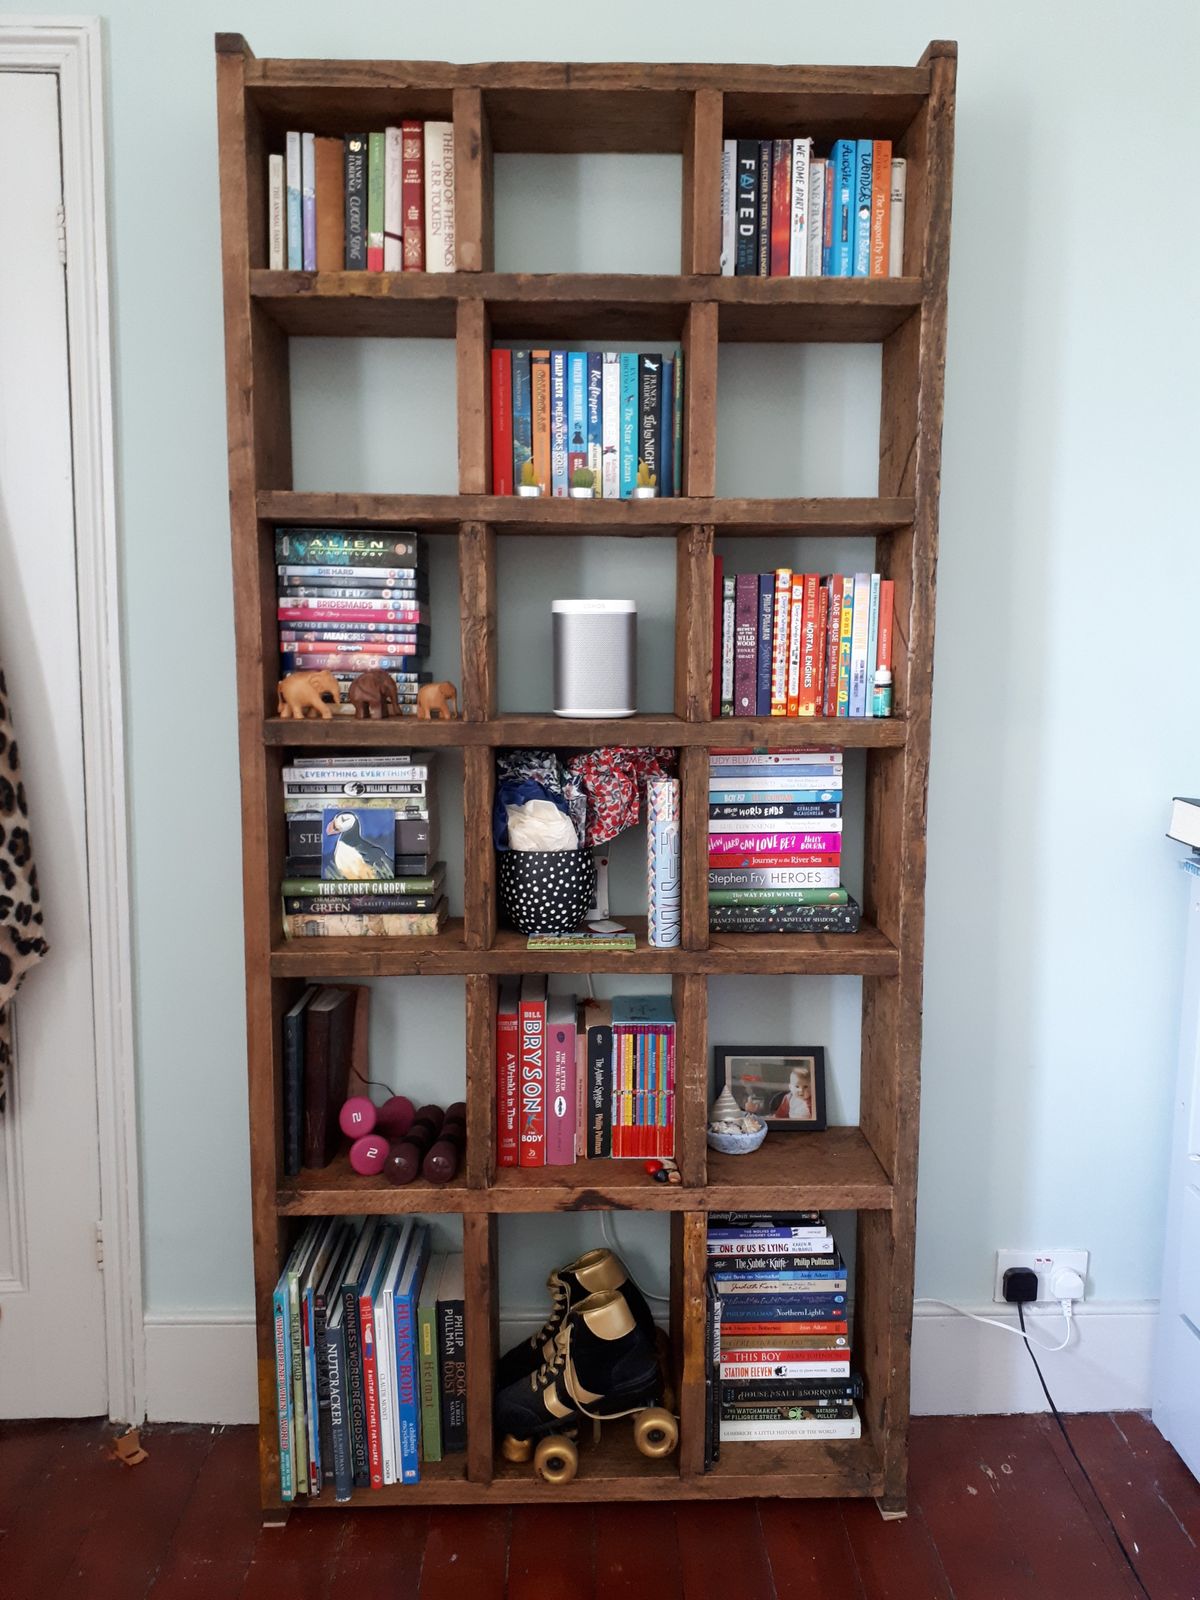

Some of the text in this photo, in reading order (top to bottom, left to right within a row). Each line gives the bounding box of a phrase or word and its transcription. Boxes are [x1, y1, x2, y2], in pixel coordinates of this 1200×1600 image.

[795, 145, 805, 212] WE COME APART
[442, 132, 454, 267] THE LORD OF THE RINGS
[739, 159, 756, 237] FATED
[810, 168, 822, 242] ANNE FRANK
[349, 196, 361, 260] CUCKOO SONG
[874, 194, 885, 274] The Dragonfly Pool
[554, 354, 563, 398] PHILIP REEVE
[643, 374, 651, 412] HARDINGE
[649, 374, 657, 407] FRANCES
[624, 407, 633, 422] The
[624, 424, 633, 444] Star
[554, 453, 564, 476] GOLD
[624, 454, 634, 483] Kazan
[311, 539, 384, 548] ALIEN
[808, 577, 816, 598] PHILIP
[317, 600, 373, 609] BRIDESMAIDS
[762, 594, 772, 613] PHILIP
[762, 613, 771, 641] PULLMAN
[829, 593, 841, 688] SLADE HOUSE David Mitchell
[804, 621, 814, 688] MORTAL ENGINES
[739, 806, 784, 816] WORLD ENDS
[723, 834, 796, 852] HARD CAN LOVE BE?
[318, 882, 406, 895] THE SECRET GARDEN
[709, 872, 822, 885] Stephen Fry HEROES
[310, 902, 351, 912] GREEN
[522, 1020, 543, 1113] BRYSON
[506, 1053, 516, 1130] A Wrinkle in Time
[592, 1058, 605, 1109] The Amber Spyglass
[352, 1112, 362, 1123] 2
[593, 1113, 604, 1155] Philip Pullman
[367, 1147, 378, 1158] 2
[720, 1244, 789, 1253] ONE OF US IS LYING
[794, 1258, 835, 1267] Philip Pullman
[735, 1258, 789, 1270] The Subtle Knife
[291, 1313, 300, 1324] THE
[776, 1308, 824, 1317] Northern Lights
[445, 1309, 455, 1355] PULLMAN
[454, 1315, 464, 1347] PHILIP
[275, 1315, 288, 1410] WHAT HAPPENED WHEN
[293, 1353, 301, 1381] REVEALED
[396, 1303, 414, 1407] HUMAN BODY
[735, 1352, 782, 1361] THIS BOY
[326, 1343, 342, 1425] NUTCRACKER
[345, 1292, 365, 1466] GUINNESS WORLD RECORDS 2013
[424, 1361, 434, 1409] Heimat
[445, 1369, 455, 1395] DUST
[455, 1362, 466, 1397] BOOK
[724, 1367, 772, 1377] STATION ELEVEN
[380, 1399, 388, 1421] MONET
[280, 1418, 288, 1450] WORLD
[402, 1419, 410, 1458] encyclopedia
[408, 1427, 417, 1455] children's
[371, 1440, 379, 1465] CHILDREN
